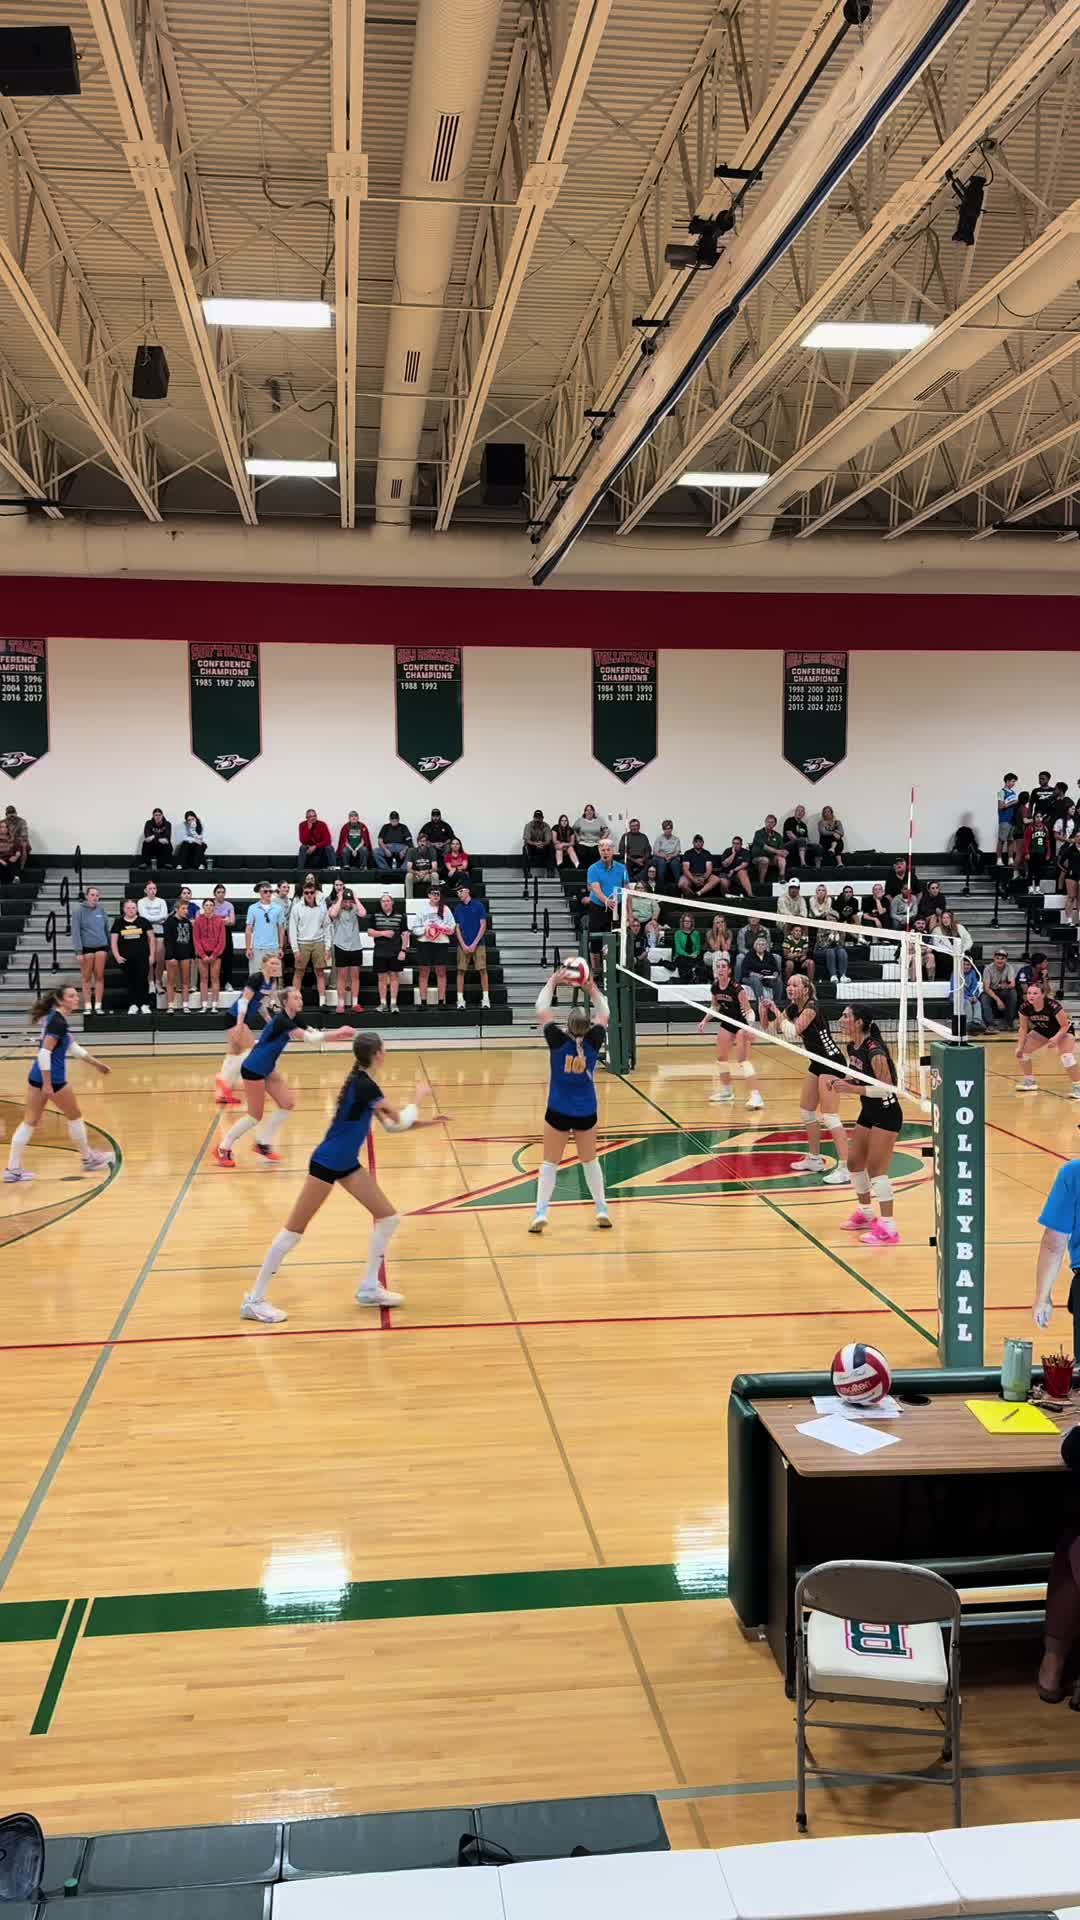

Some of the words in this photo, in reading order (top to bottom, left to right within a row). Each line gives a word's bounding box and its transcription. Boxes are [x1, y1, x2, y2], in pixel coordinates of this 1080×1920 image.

[0, 656, 38, 664] FERENCE
[197, 660, 251, 668] CONFERENCE
[200, 668, 249, 676] CHAMPIONS
[600, 666, 650, 674] CONFERENCE
[791, 667, 841, 675] CONFERENCE
[216, 679, 233, 687] 1987
[237, 679, 255, 687] 2000
[793, 675, 839, 683] CHAMPIONS
[1, 684, 20, 692] 2004
[421, 682, 438, 690] 1992
[1, 694, 21, 702] 2016
[24, 694, 42, 702] 2017
[597, 693, 614, 701] 1993
[617, 693, 633, 701] 2011
[636, 693, 653, 701] 2012
[788, 694, 805, 702] 2002
[827, 694, 843, 702] 2013
[788, 703, 805, 711] 2015
[807, 703, 824, 711] 2024
[955, 1080, 975, 1341] VOLLEYBALL
